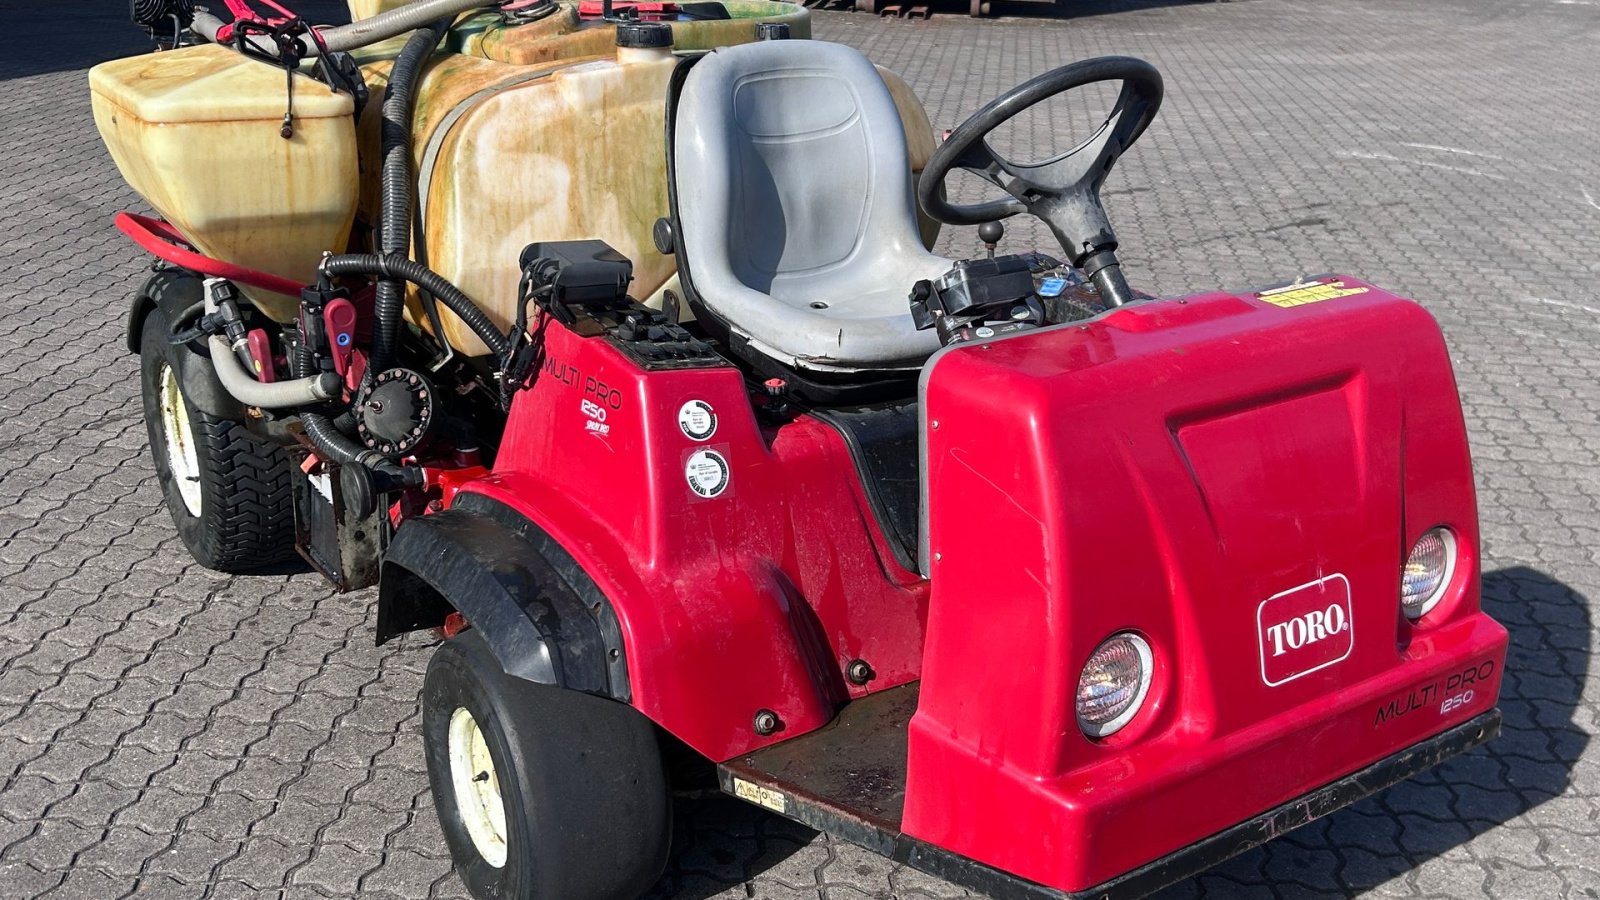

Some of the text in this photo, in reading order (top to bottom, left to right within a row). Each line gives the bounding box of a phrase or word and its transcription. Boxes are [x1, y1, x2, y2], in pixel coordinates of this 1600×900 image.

[544, 357, 622, 409] MULTI PRO
[580, 398, 607, 422] 1250
[1267, 603, 1345, 657] TORO
[1374, 660, 1494, 726] MULTI PRO
[1440, 689, 1474, 714] 1250
